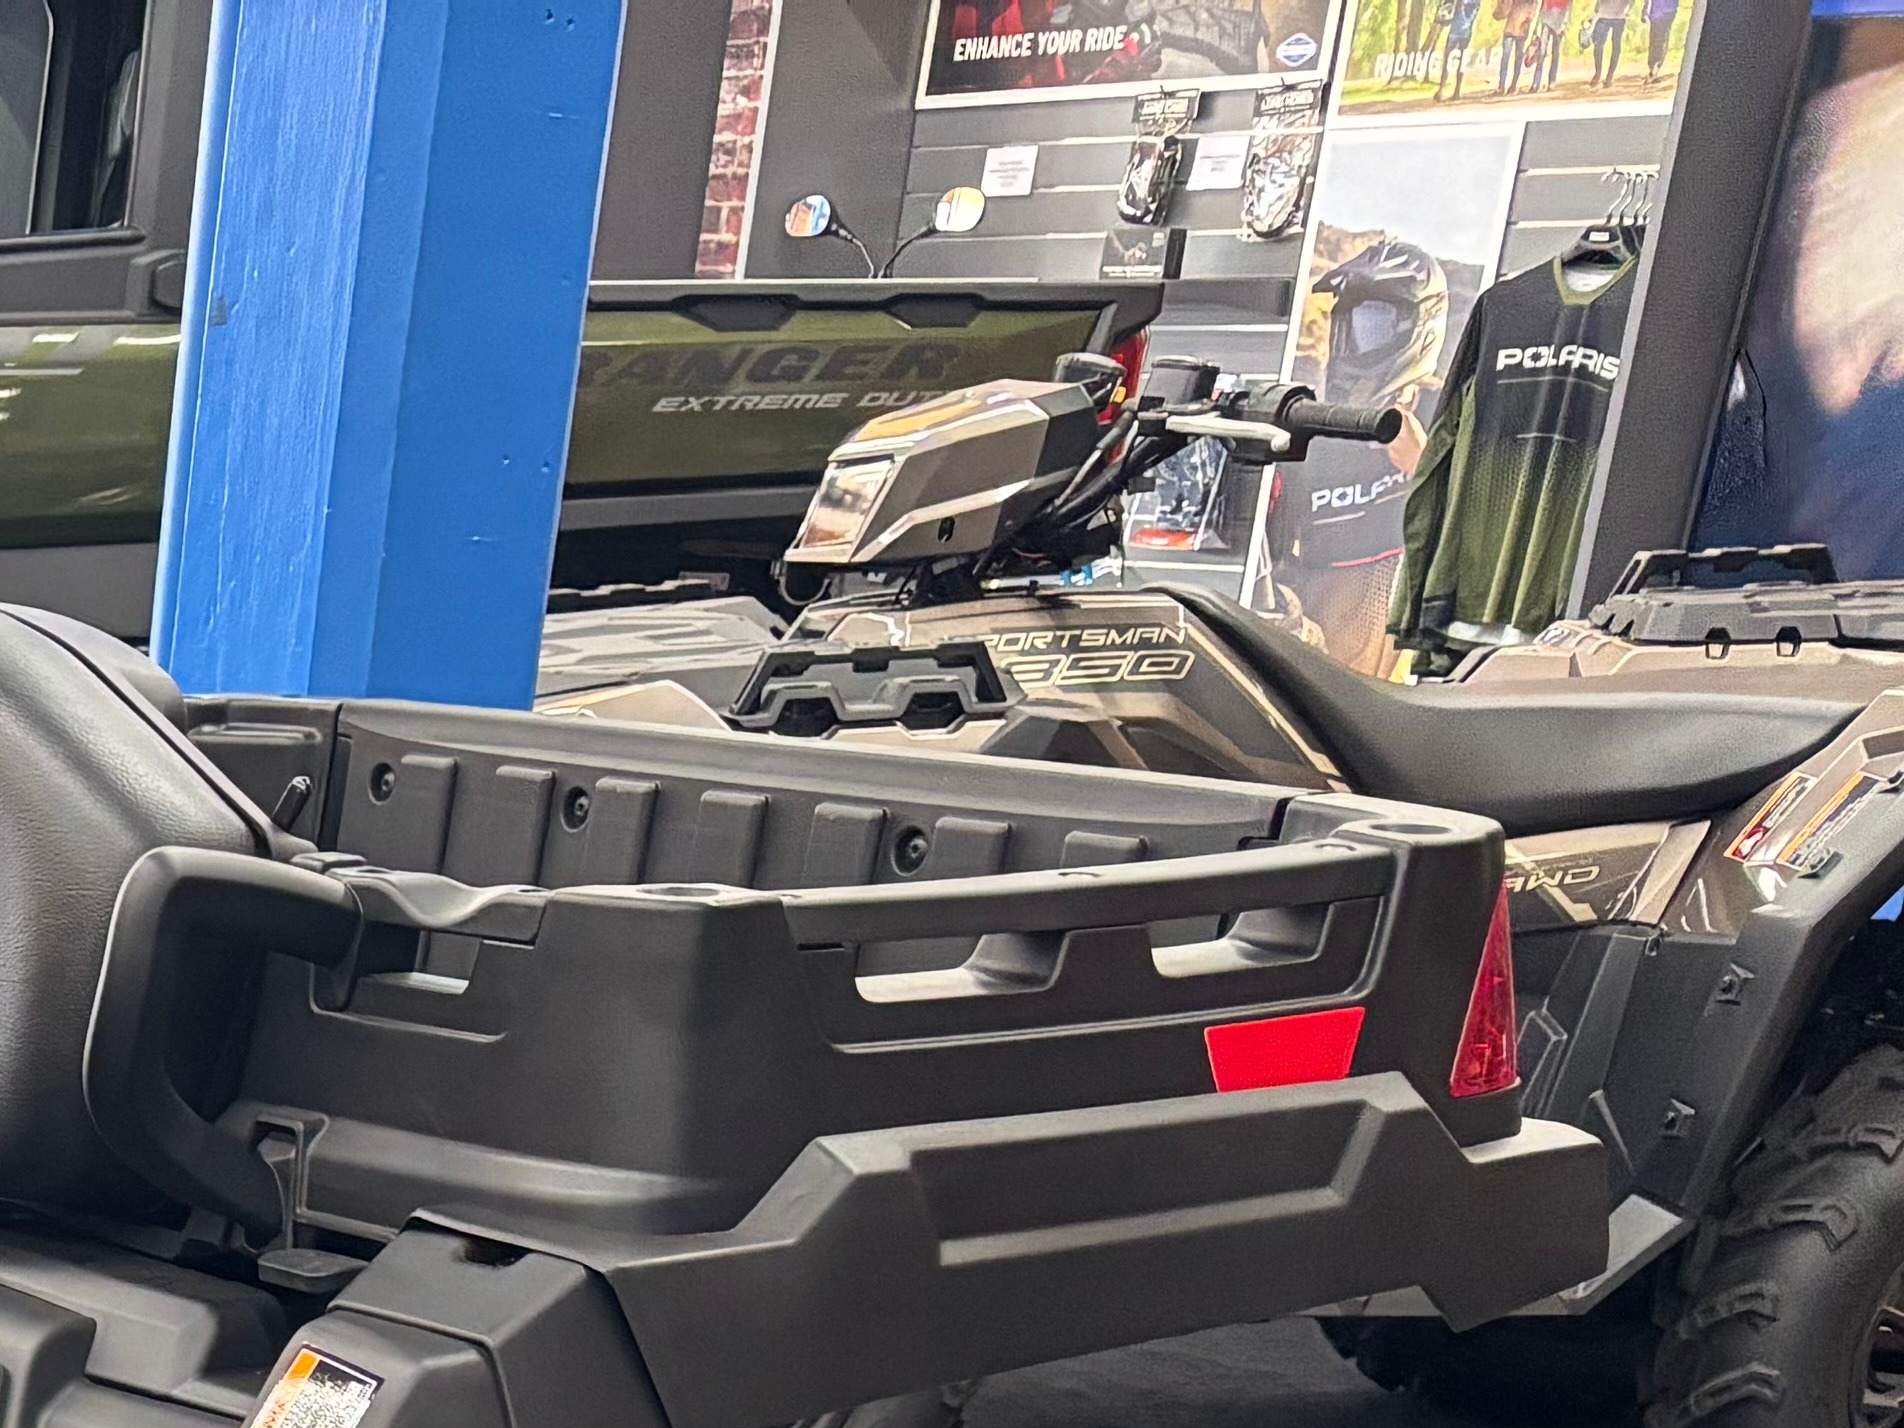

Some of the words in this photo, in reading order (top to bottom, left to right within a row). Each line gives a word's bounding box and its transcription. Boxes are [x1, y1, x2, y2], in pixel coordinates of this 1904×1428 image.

[953, 32, 1033, 62] ENHANCE
[1036, 29, 1082, 56] YOUR
[1084, 25, 1129, 52] RIDE
[1373, 50, 1443, 80] RIDING
[1495, 344, 1621, 381] POLARIS
[651, 392, 851, 413] EXTREME
[976, 627, 1185, 651] PORTSMAN
[1503, 866, 1600, 893] AWD
